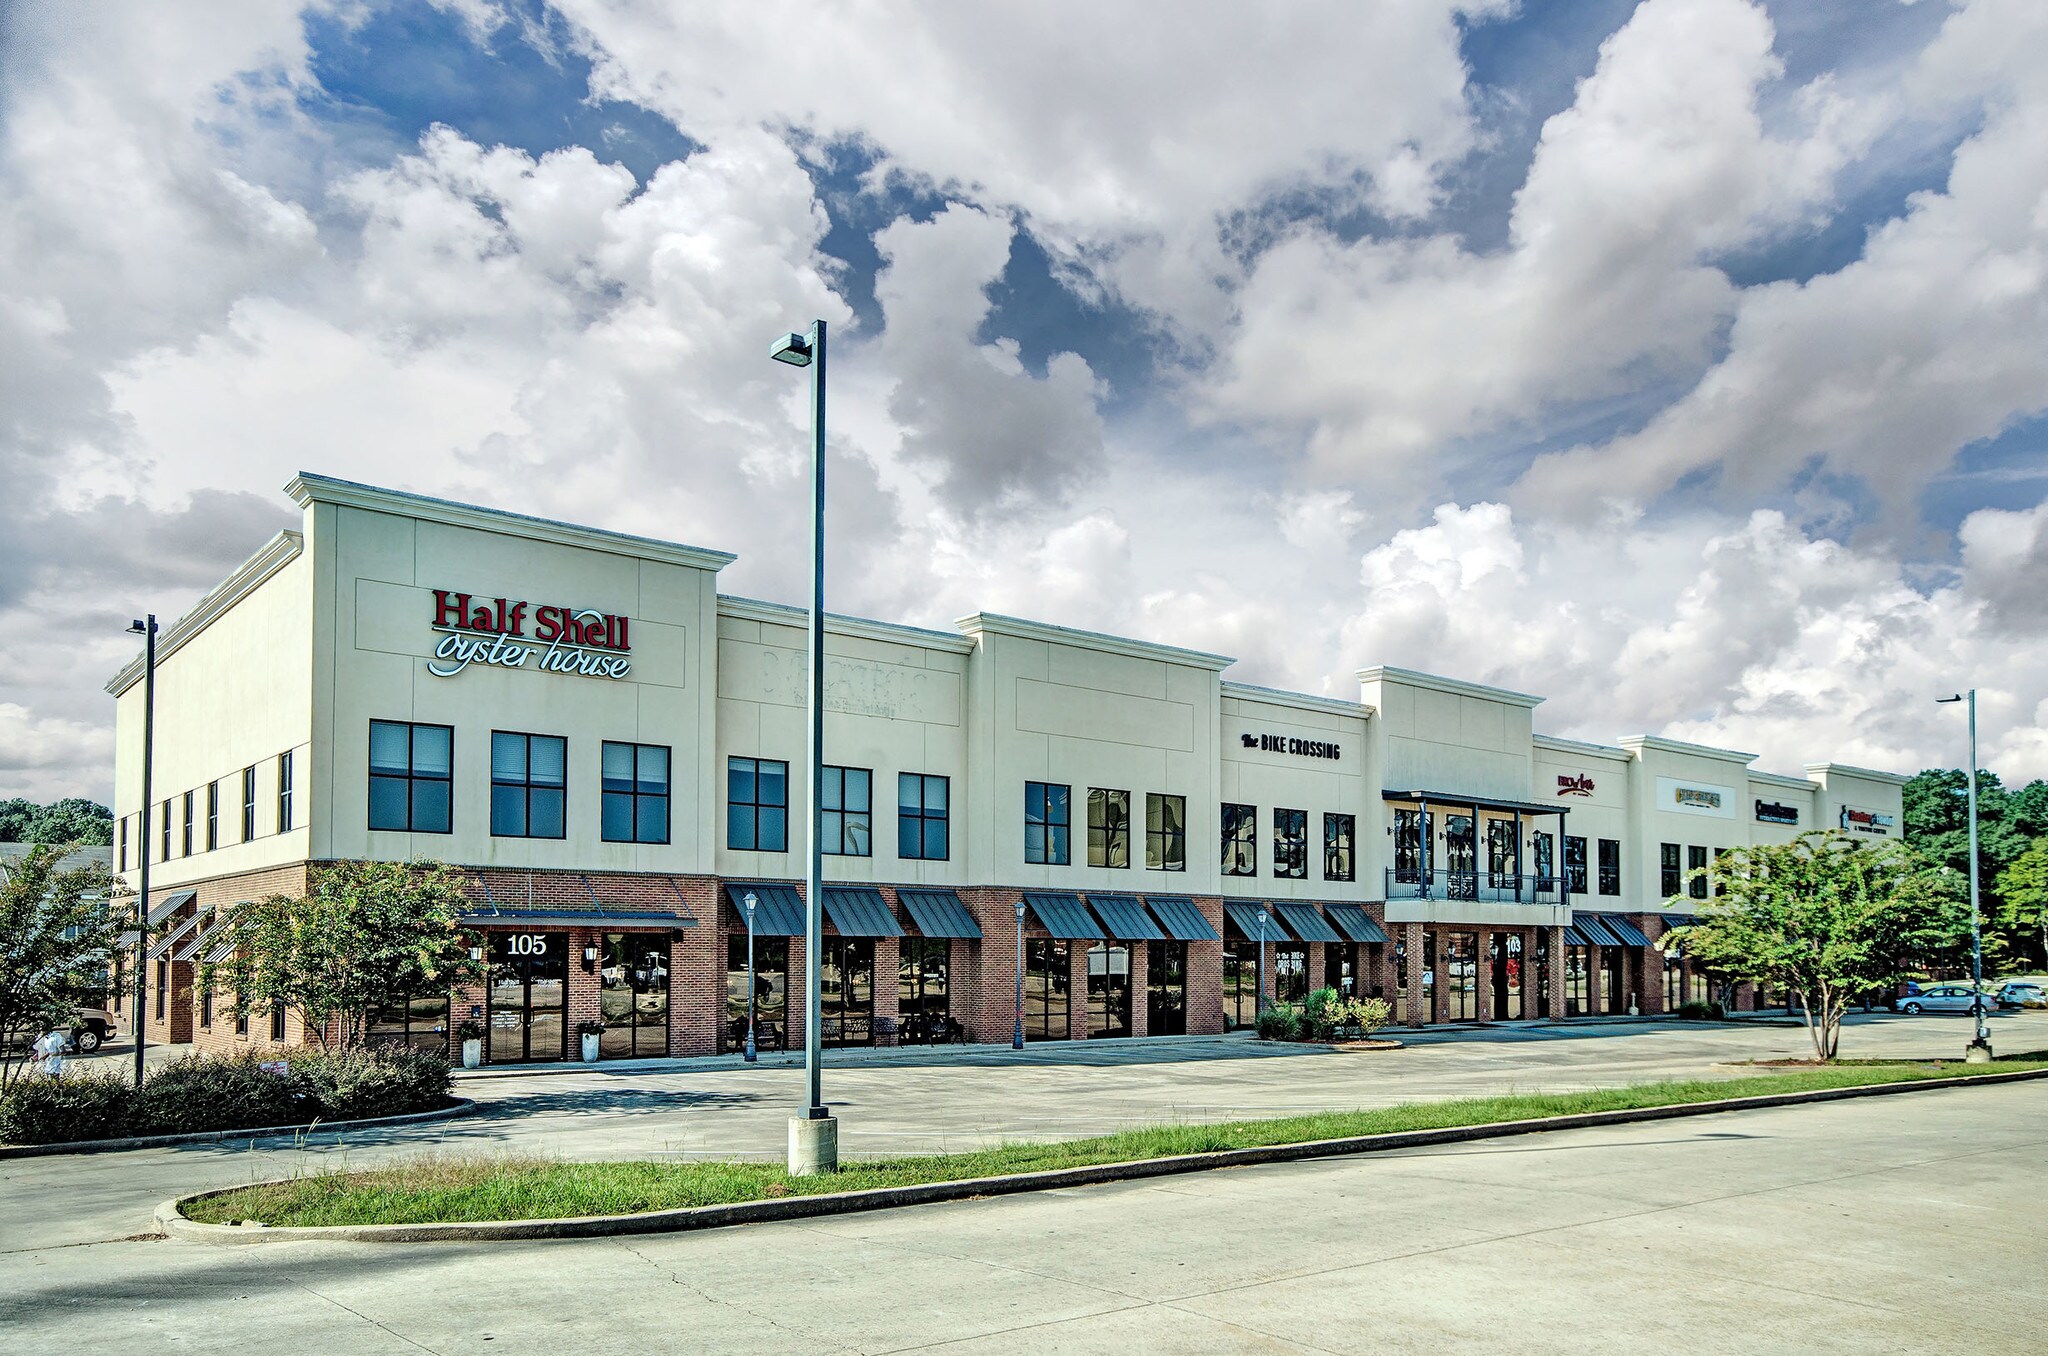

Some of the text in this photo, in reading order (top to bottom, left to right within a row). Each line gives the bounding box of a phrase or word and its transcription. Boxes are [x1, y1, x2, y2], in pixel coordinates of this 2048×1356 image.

[432, 589, 631, 651] Half Shell
[427, 630, 631, 679] oyster house
[1261, 733, 1286, 753] BIKE
[1288, 737, 1340, 760] CROSSING
[507, 934, 547, 955] 105
[1506, 938, 1521, 953] 103
